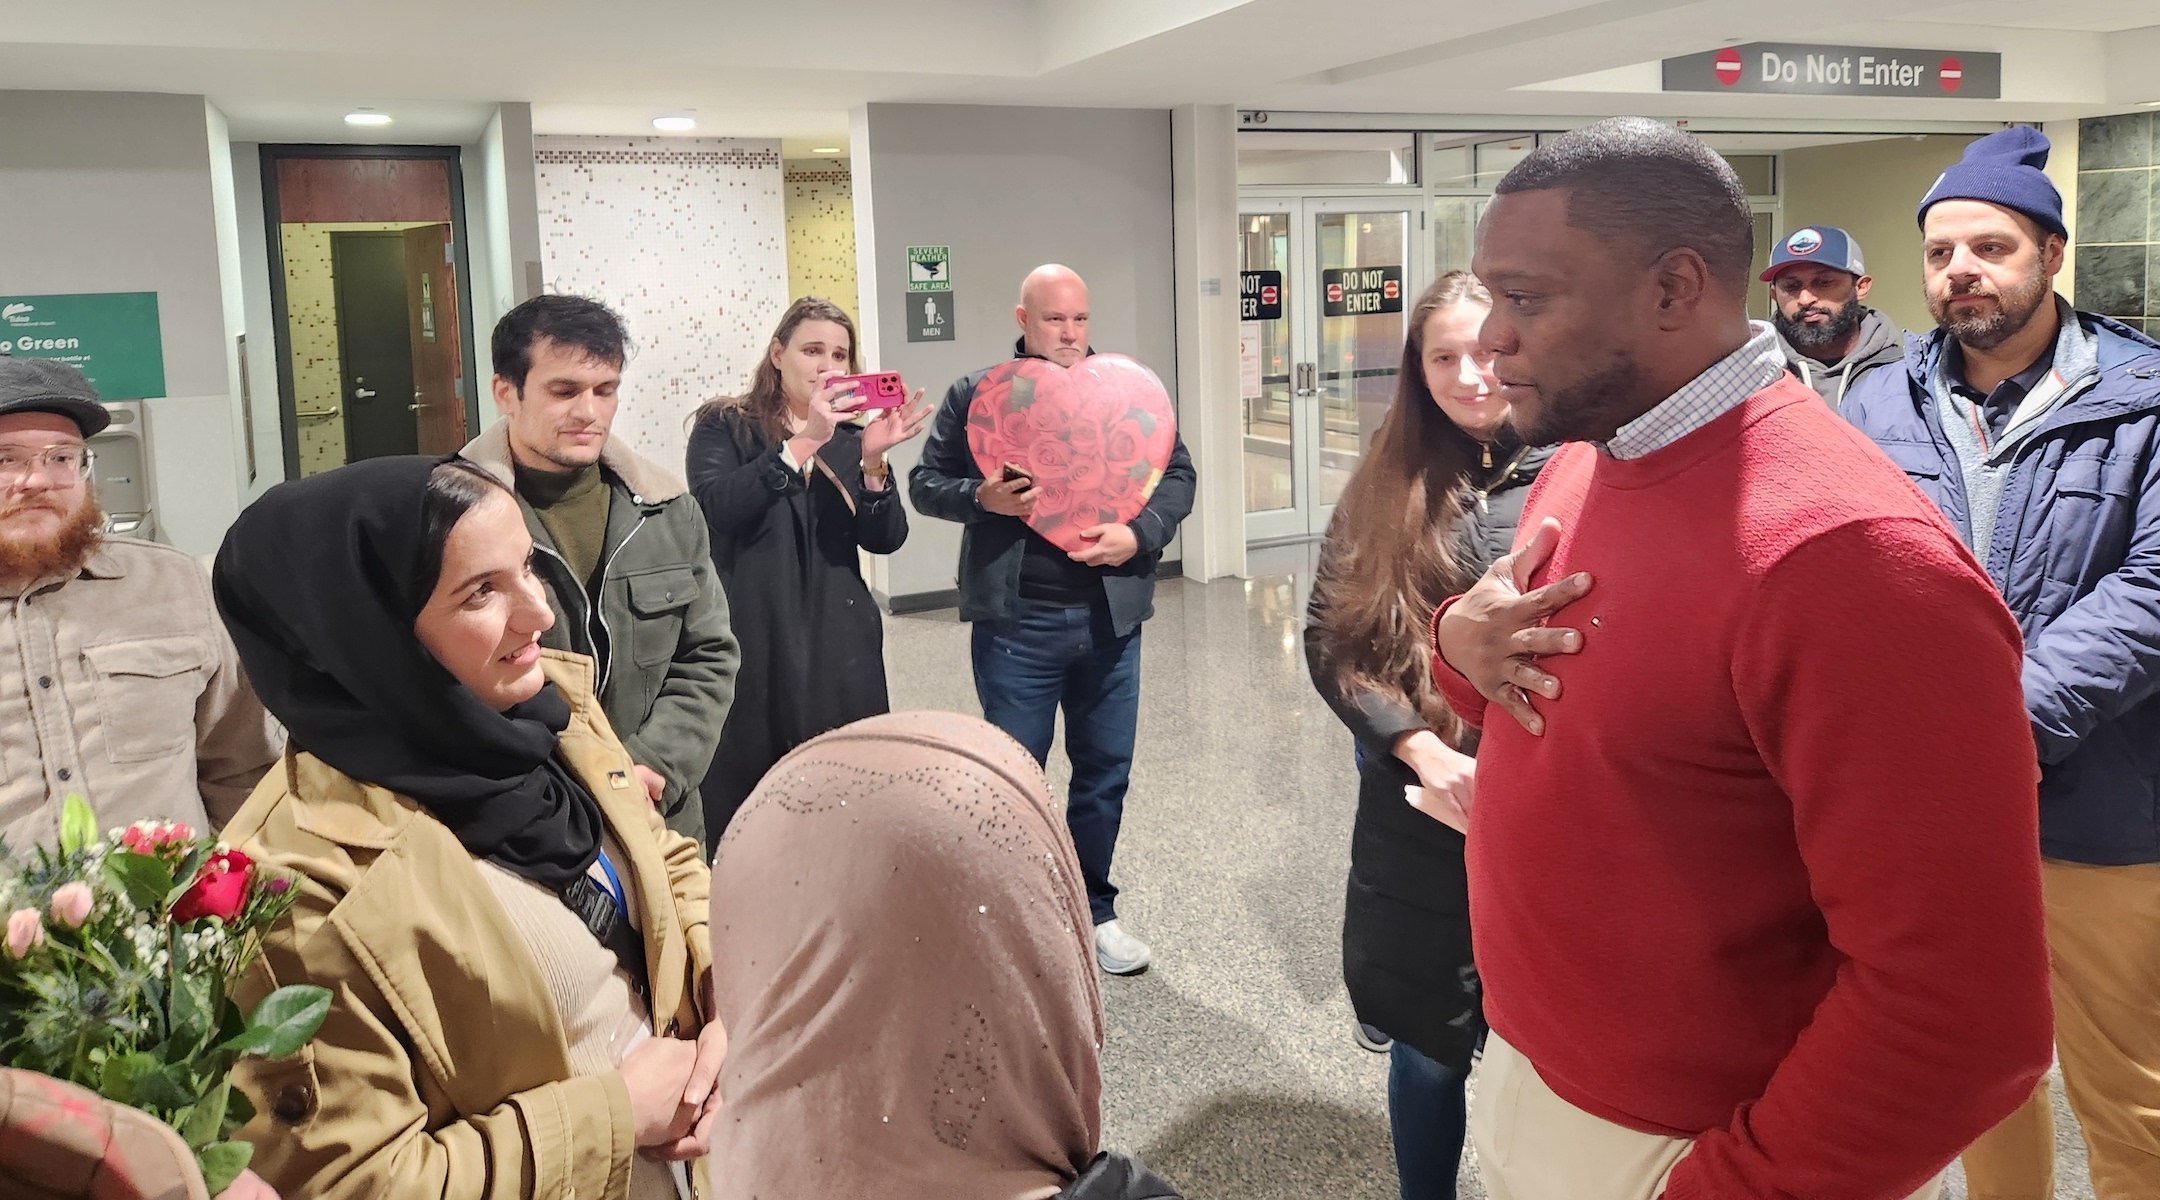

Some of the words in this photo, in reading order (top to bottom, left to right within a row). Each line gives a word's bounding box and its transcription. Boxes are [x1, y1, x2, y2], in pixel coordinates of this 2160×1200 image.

[1762, 52, 1798, 83] Do
[1806, 54, 1851, 84] Not
[1859, 56, 1924, 87] Enter
[913, 247, 944, 255] SEVERE
[910, 254, 947, 262] WEATHER
[910, 282, 928, 290] SAFE
[931, 282, 950, 290] AREA
[1342, 271, 1358, 290] DO
[1362, 270, 1384, 289] NOT
[1346, 292, 1381, 312] ENTER
[922, 327, 941, 336] MEN
[17, 336, 79, 351] Green
